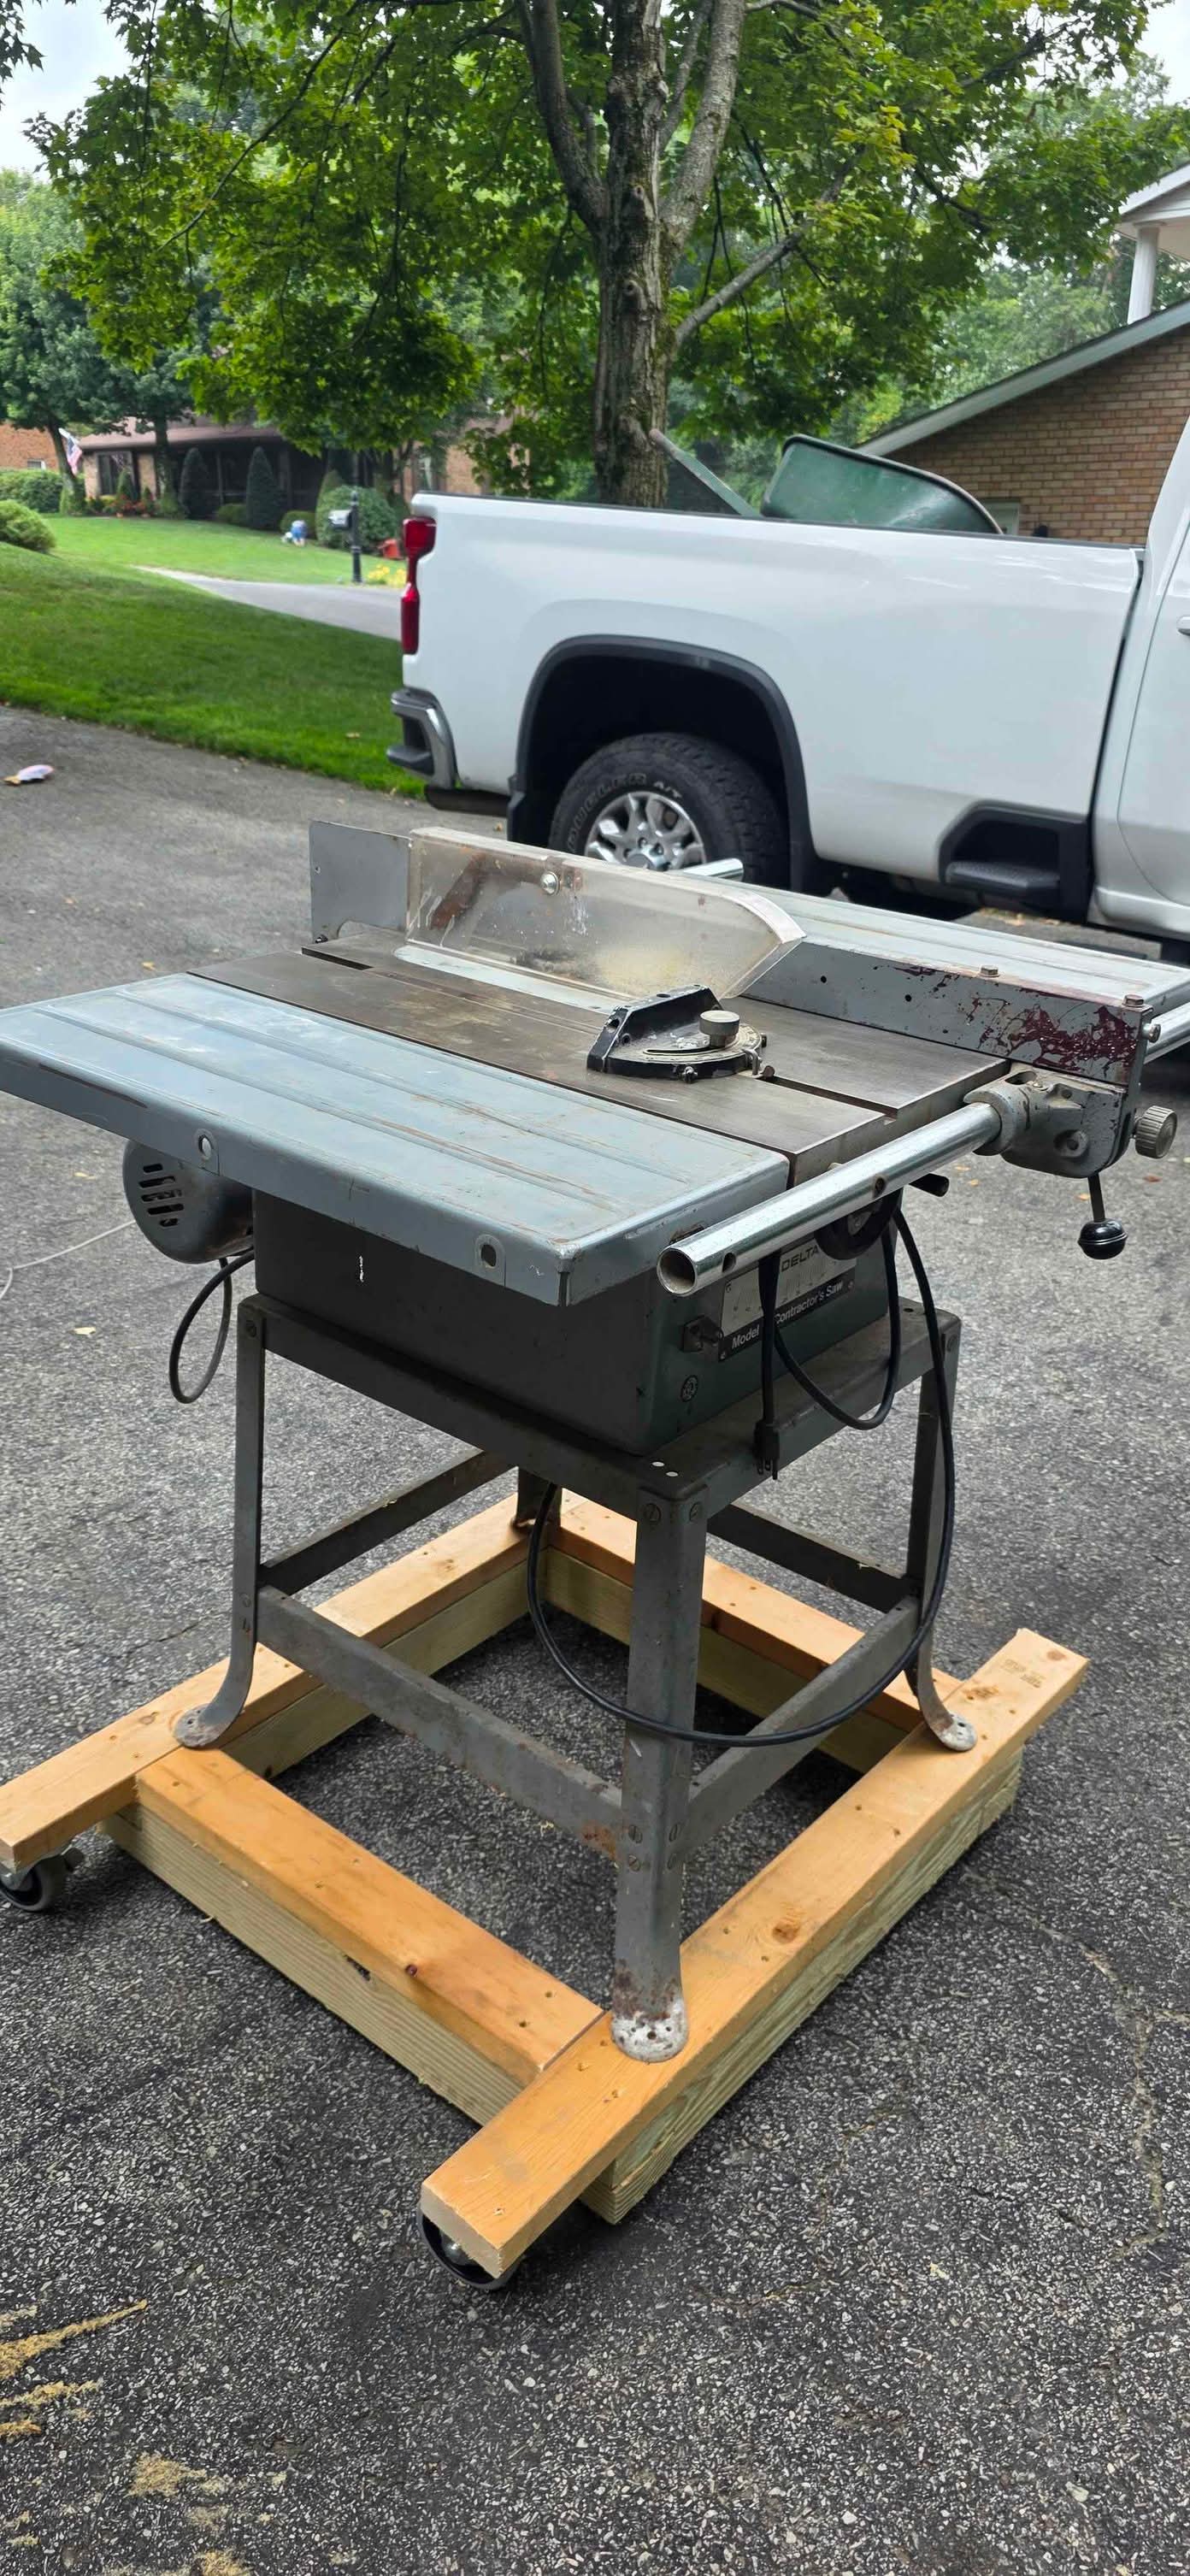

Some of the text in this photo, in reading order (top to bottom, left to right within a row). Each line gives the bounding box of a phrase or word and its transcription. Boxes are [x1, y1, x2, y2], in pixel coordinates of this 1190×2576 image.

[781, 1245, 820, 1272] DELTA
[731, 1324, 760, 1350] Model
[774, 1290, 825, 1324] Contractor's
[826, 1281, 844, 1298] Saw
